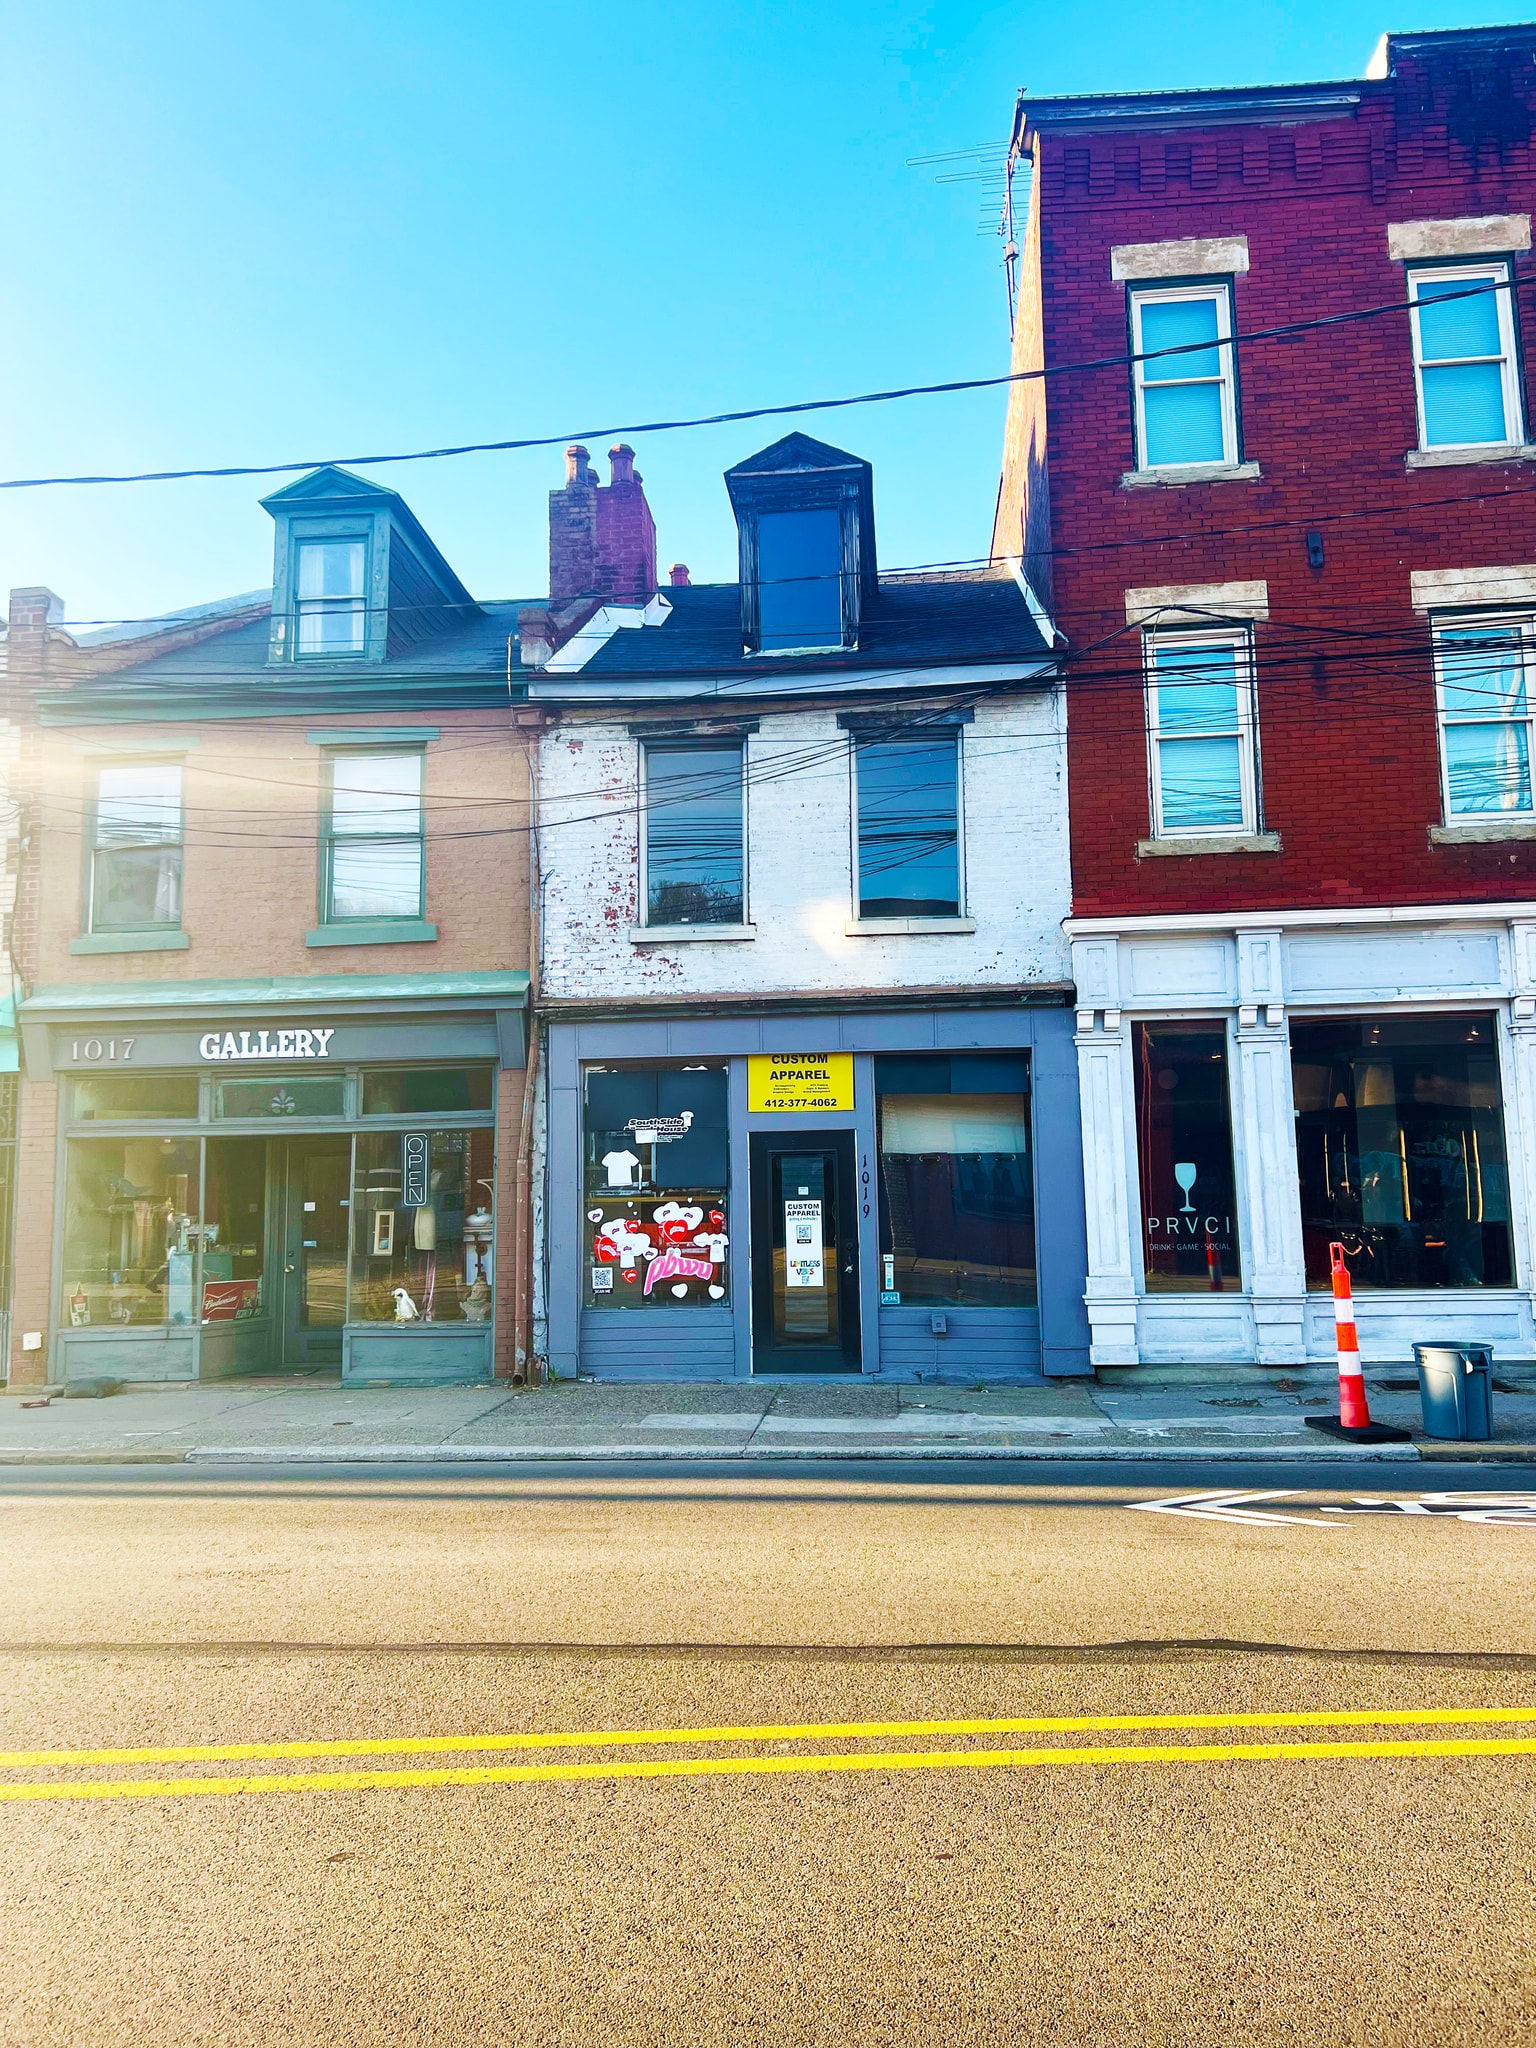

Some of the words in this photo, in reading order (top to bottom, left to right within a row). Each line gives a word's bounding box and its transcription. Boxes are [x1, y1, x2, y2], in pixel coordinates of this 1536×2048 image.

[71, 1039, 135, 1061] 1017
[200, 1029, 335, 1061] GALLERY
[771, 1054, 828, 1065] CUSTOM
[769, 1070, 831, 1081] APPAREL
[764, 1098, 837, 1108] 412-377-4062
[407, 1137, 424, 1202] OPEN
[862, 1154, 870, 1219] 1019
[1147, 1216, 1231, 1235] PRVCI
[1149, 1243, 1172, 1251] DRINK
[1176, 1243, 1199, 1251] GAME
[1204, 1242, 1231, 1250] SOCIAL
